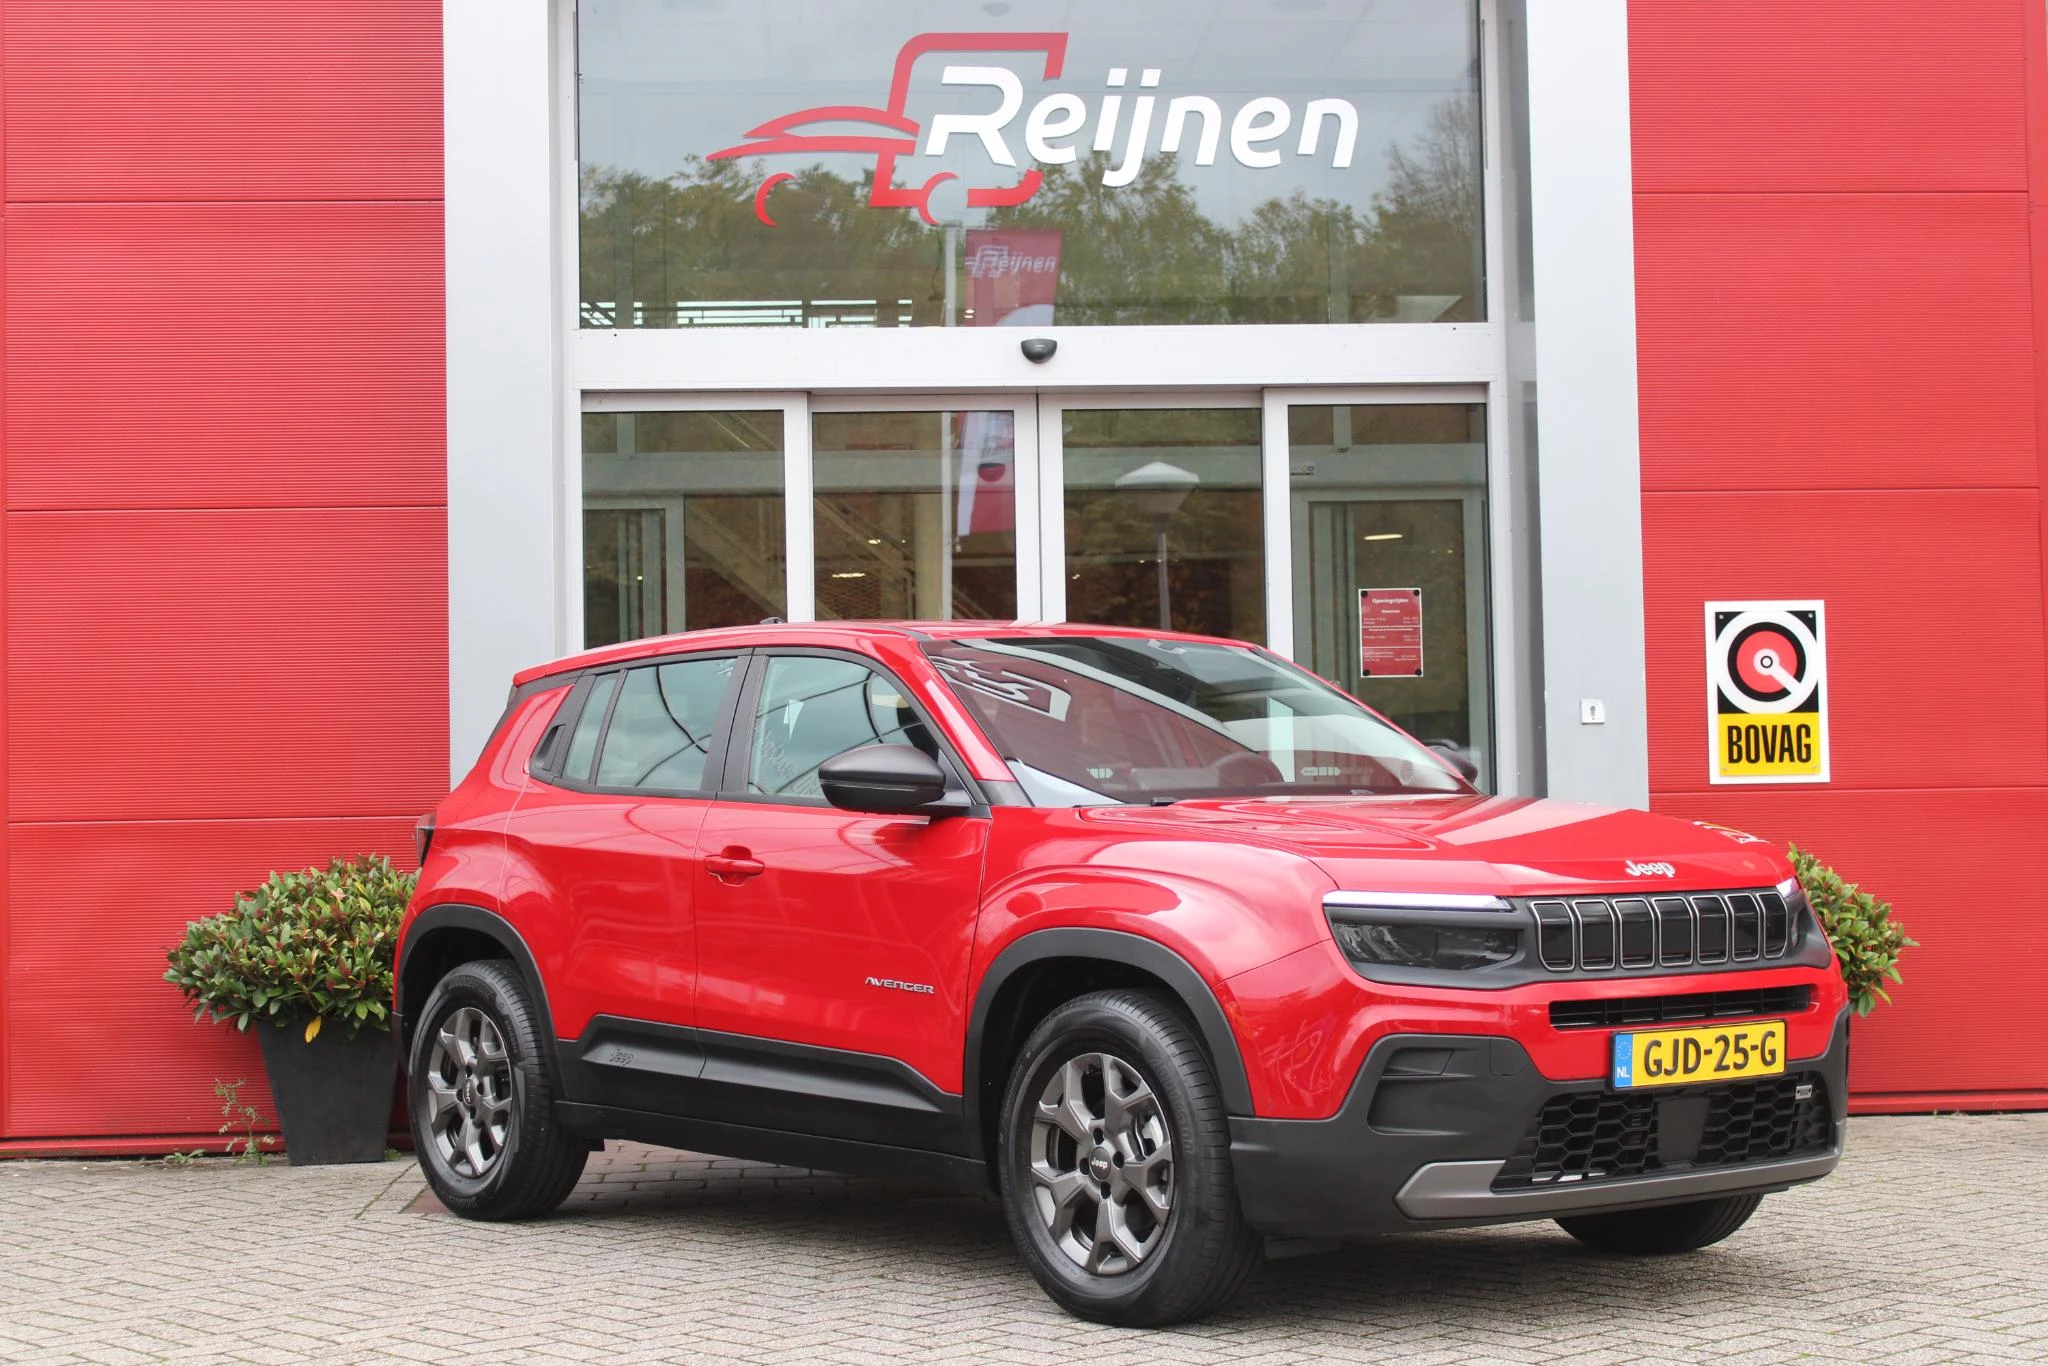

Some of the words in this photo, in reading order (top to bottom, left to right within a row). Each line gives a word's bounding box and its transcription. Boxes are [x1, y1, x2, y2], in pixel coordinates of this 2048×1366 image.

[925, 65, 1360, 188] Reijnen
[1727, 724, 1812, 764] BOVAG
[1625, 859, 1676, 878] Jeep
[865, 976, 934, 994] AVENGER
[1616, 1066, 1630, 1079] NL
[1644, 1030, 1777, 1078] GJD-25-G
[1091, 1157, 1108, 1170] Jeep
